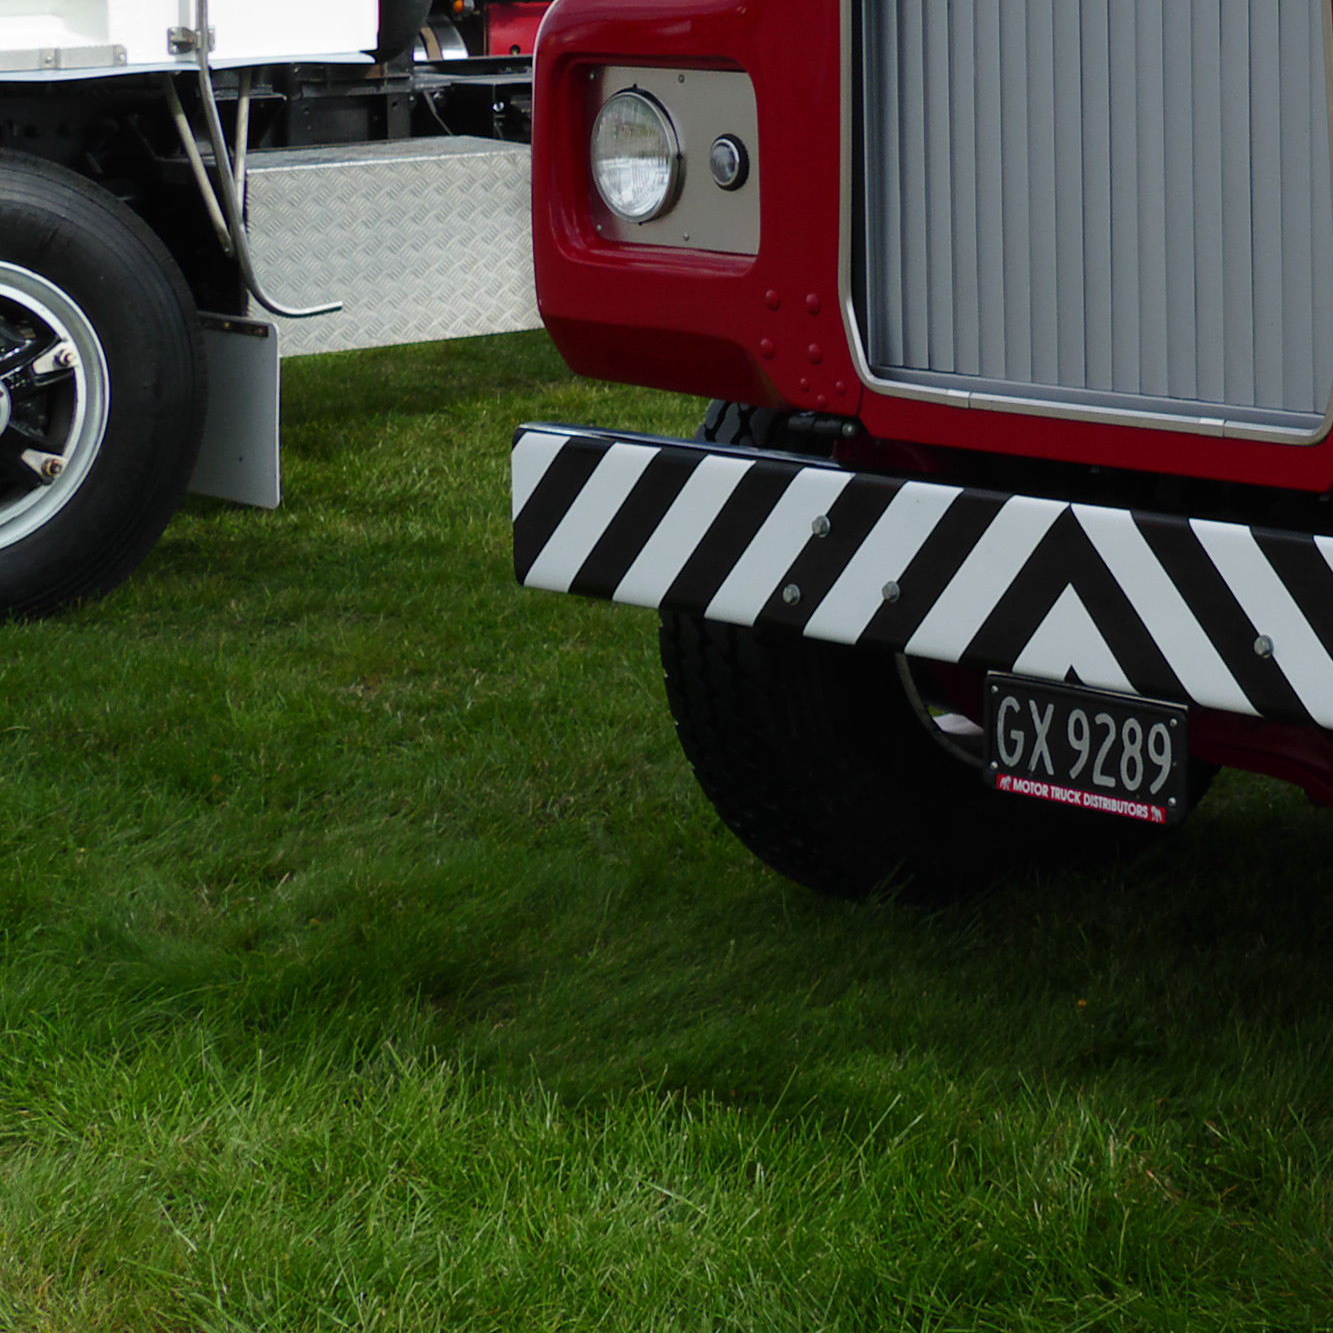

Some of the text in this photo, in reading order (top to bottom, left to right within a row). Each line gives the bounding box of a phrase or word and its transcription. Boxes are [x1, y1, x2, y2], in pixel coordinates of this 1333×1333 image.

[996, 695, 1172, 795] GX 9289
[1012, 777, 1149, 819] MOTOR TRUCK DISTRIBUTORS
